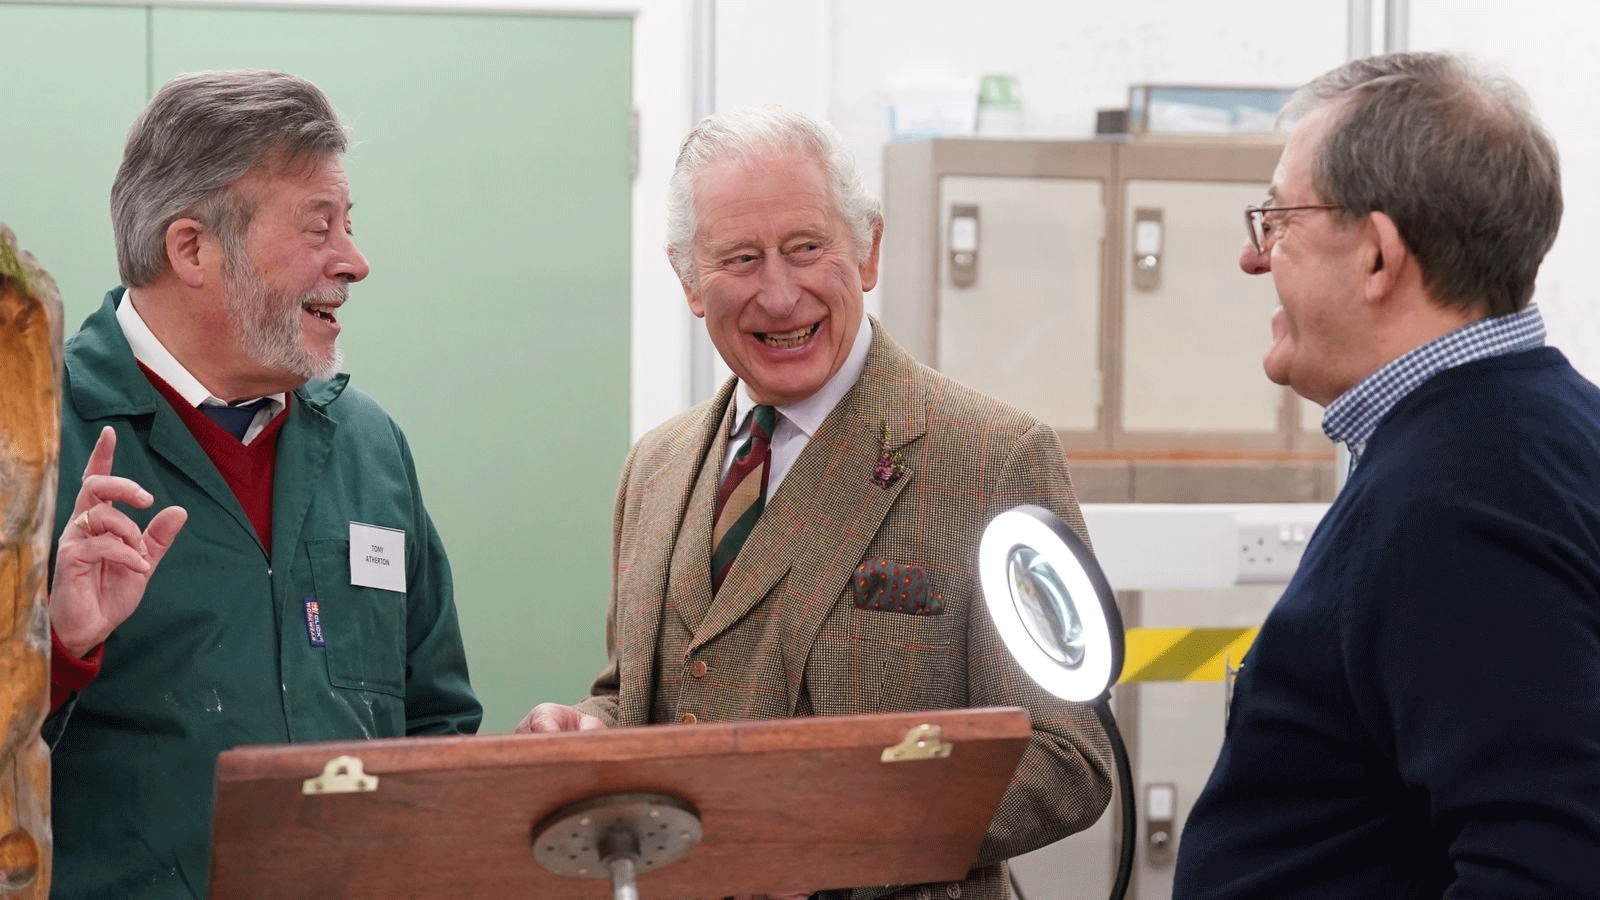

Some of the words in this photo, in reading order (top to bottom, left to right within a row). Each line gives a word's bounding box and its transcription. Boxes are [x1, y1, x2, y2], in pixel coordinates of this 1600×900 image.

[371, 544, 384, 553] TONY
[365, 555, 390, 566] ATHERTON
[314, 614, 322, 638] CLICK
